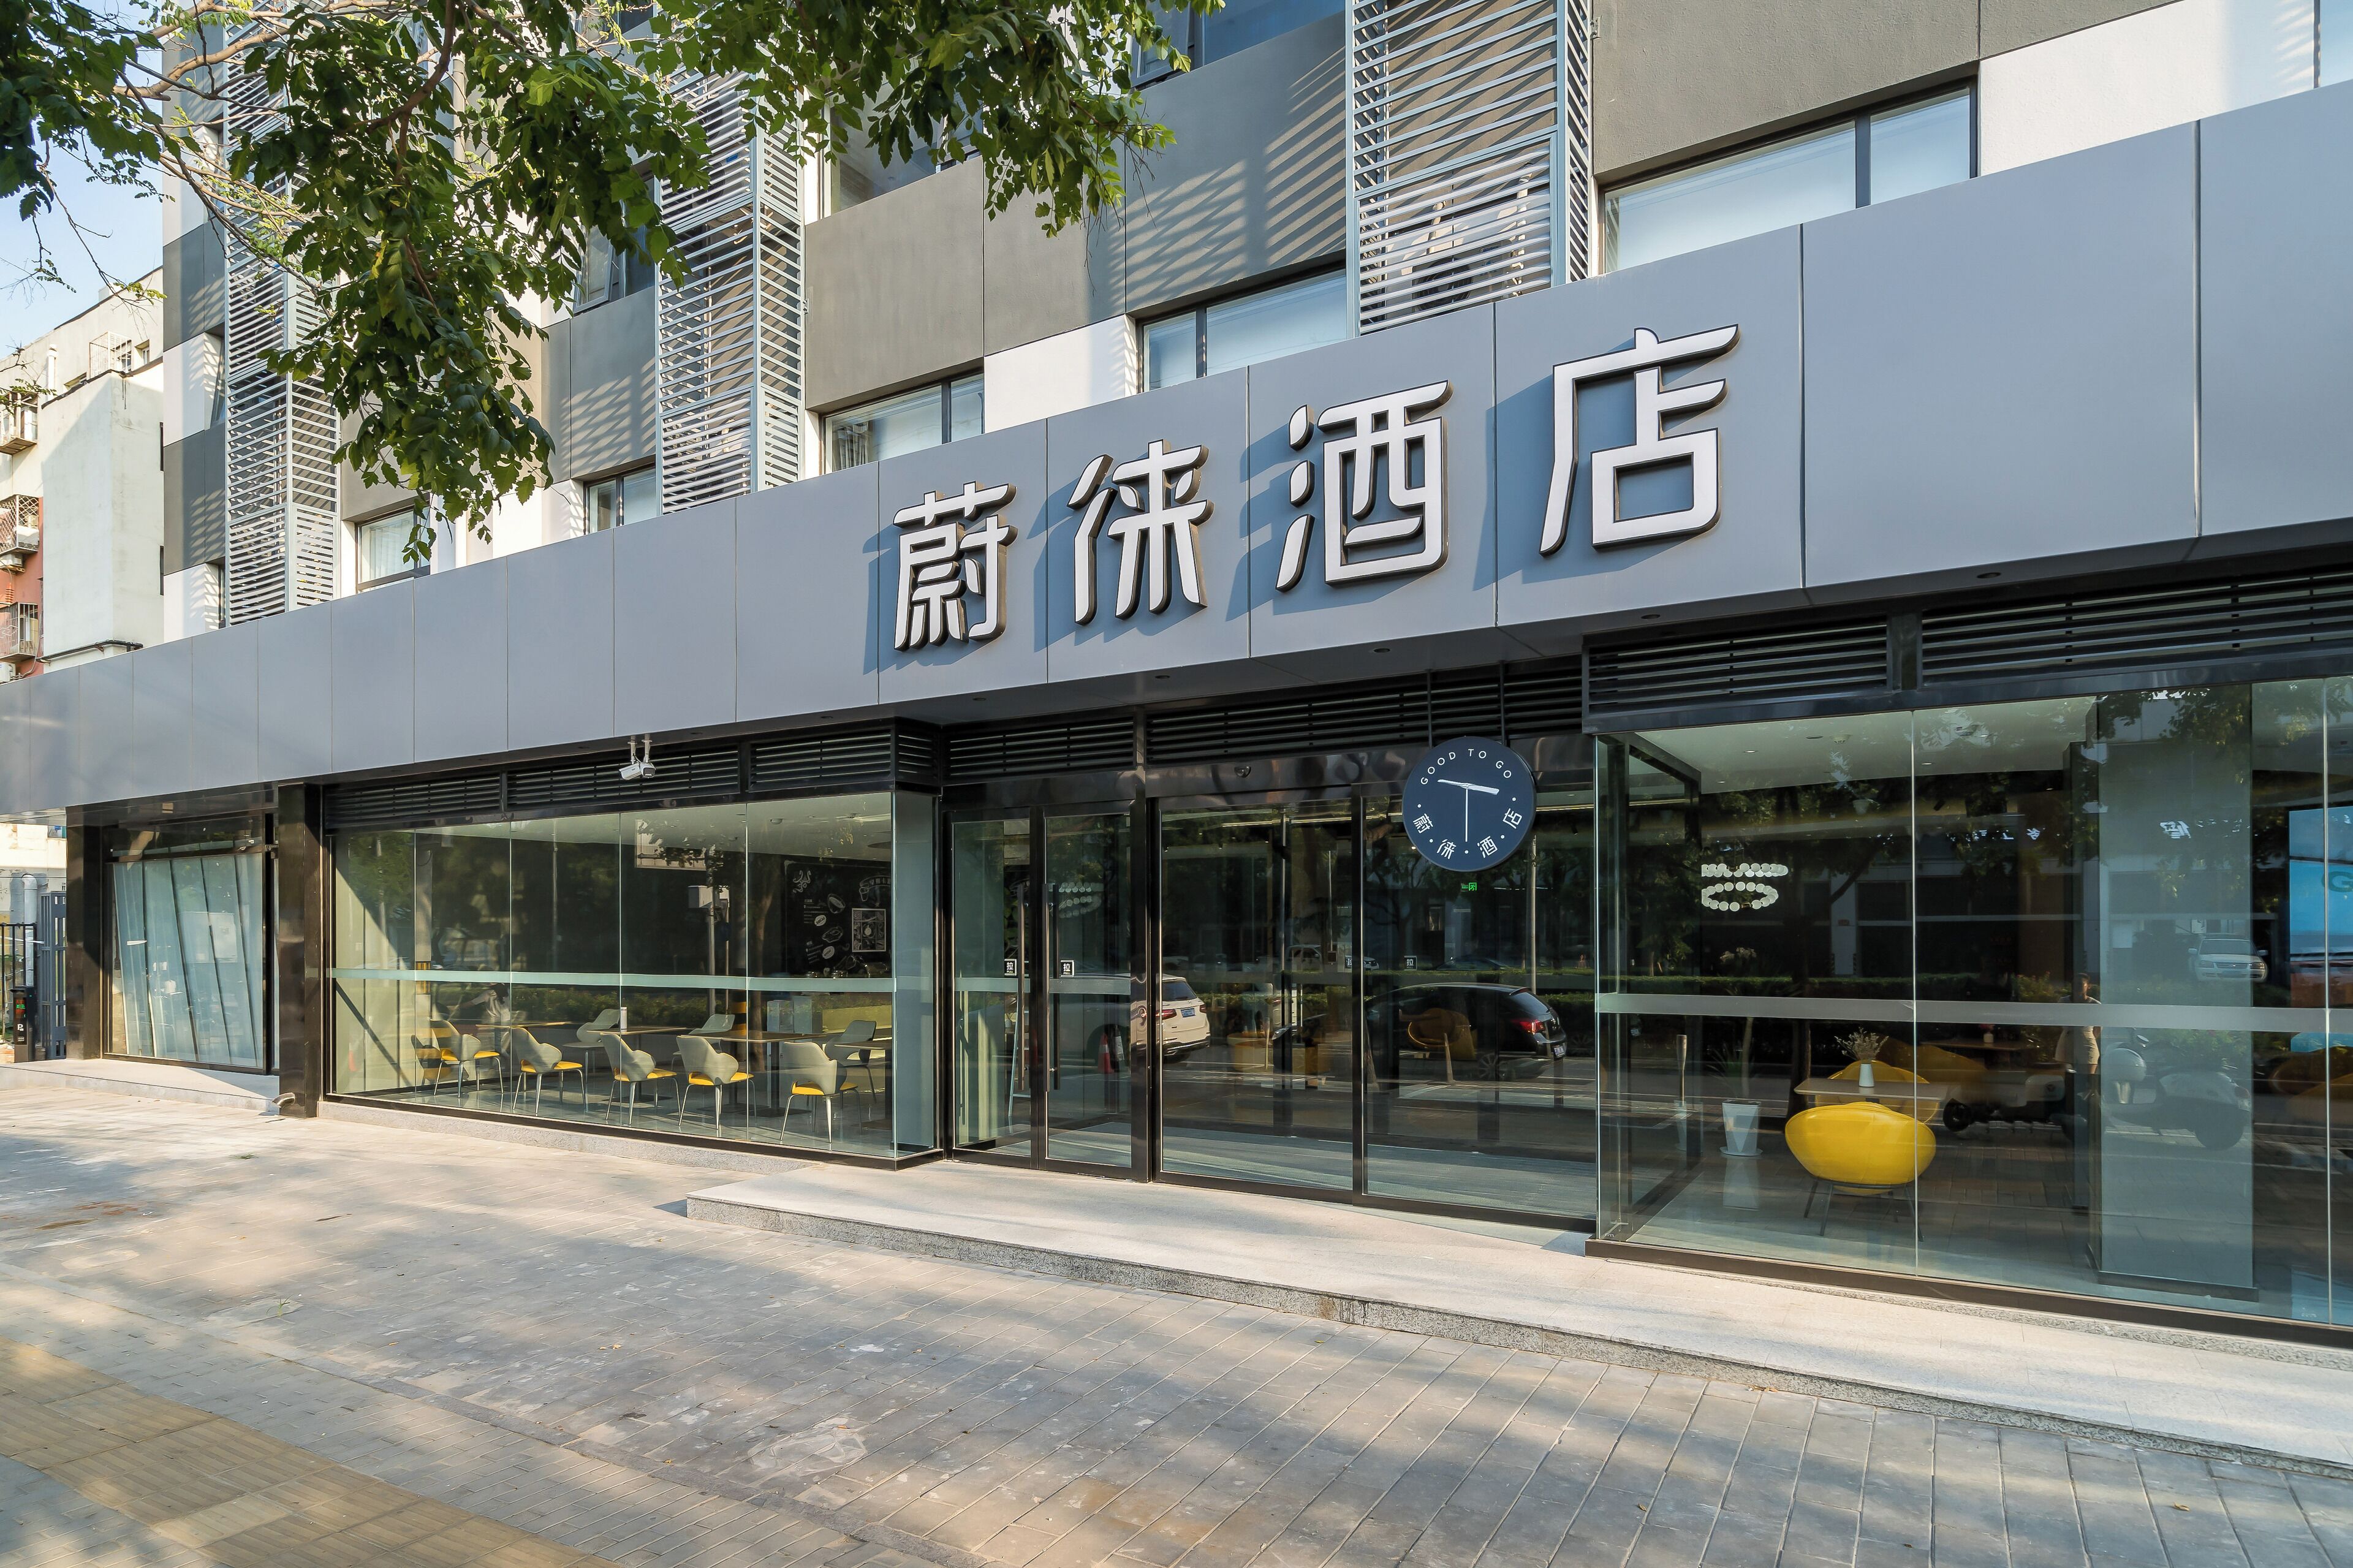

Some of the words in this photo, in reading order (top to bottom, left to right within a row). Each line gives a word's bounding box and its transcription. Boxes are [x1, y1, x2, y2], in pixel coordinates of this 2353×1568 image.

[892, 323, 1740, 652] 蔚徕酒店
[1420, 751, 1456, 785] GOOD
[1468, 748, 1487, 759] TO
[1495, 760, 1512, 779] GO
[1006, 961, 1014, 971] 拉
[1063, 963, 1071, 972] 拉
